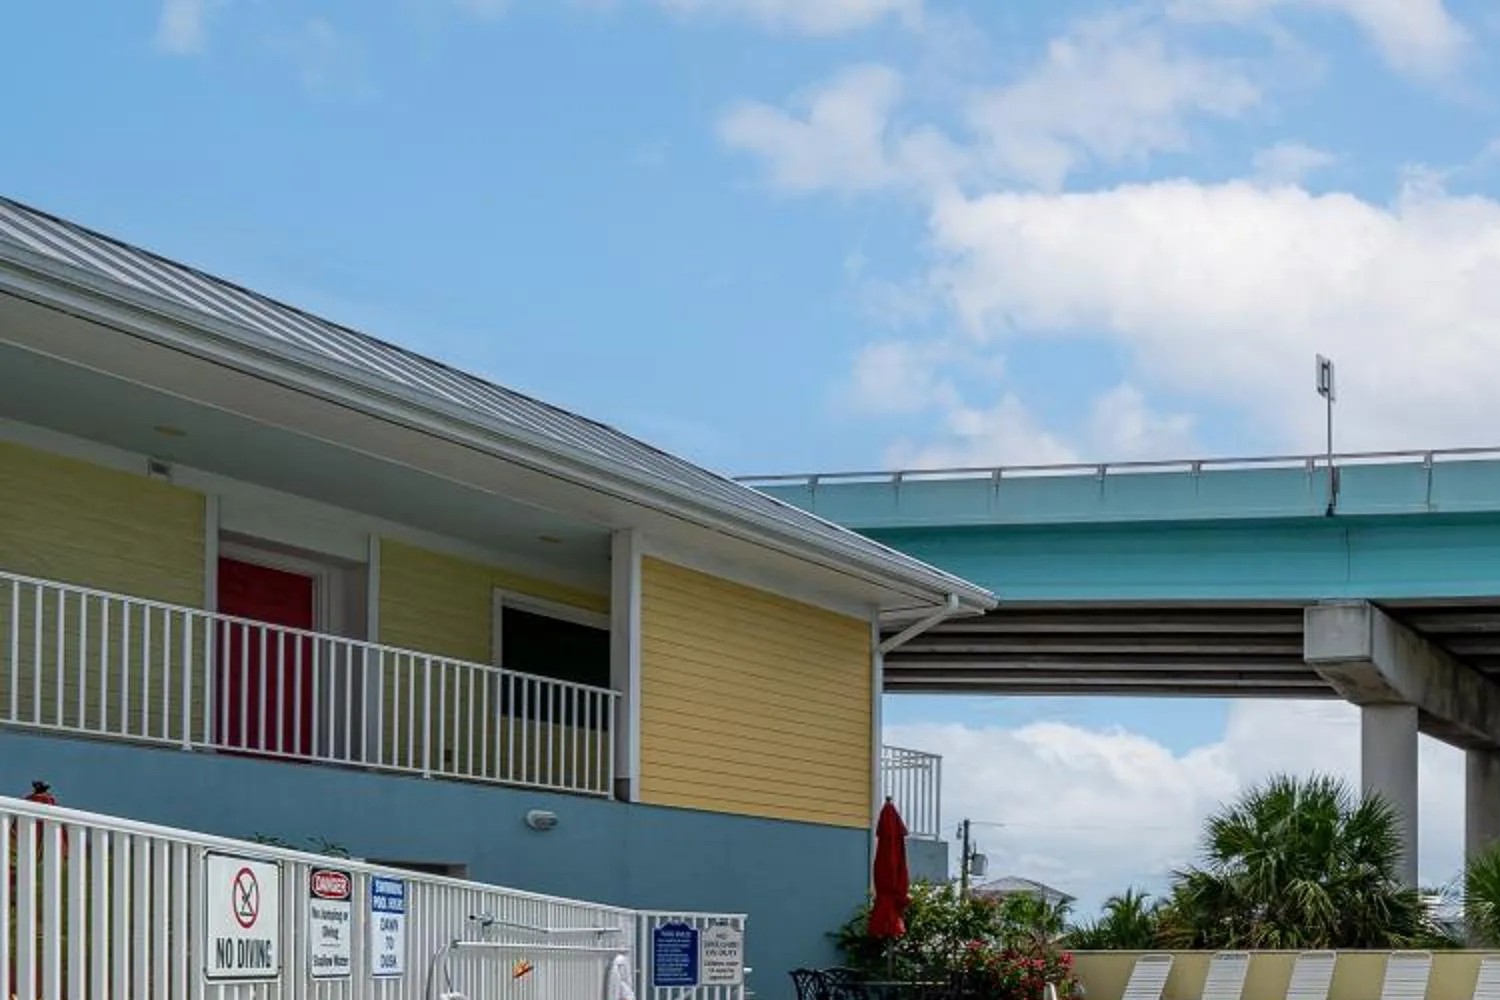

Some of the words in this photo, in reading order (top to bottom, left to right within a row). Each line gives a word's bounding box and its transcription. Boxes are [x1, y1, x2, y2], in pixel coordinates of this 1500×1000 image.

[316, 876, 346, 893] DANGER
[381, 918, 398, 931] DAWN
[216, 938, 234, 968] NO
[238, 939, 271, 968] DIVING
